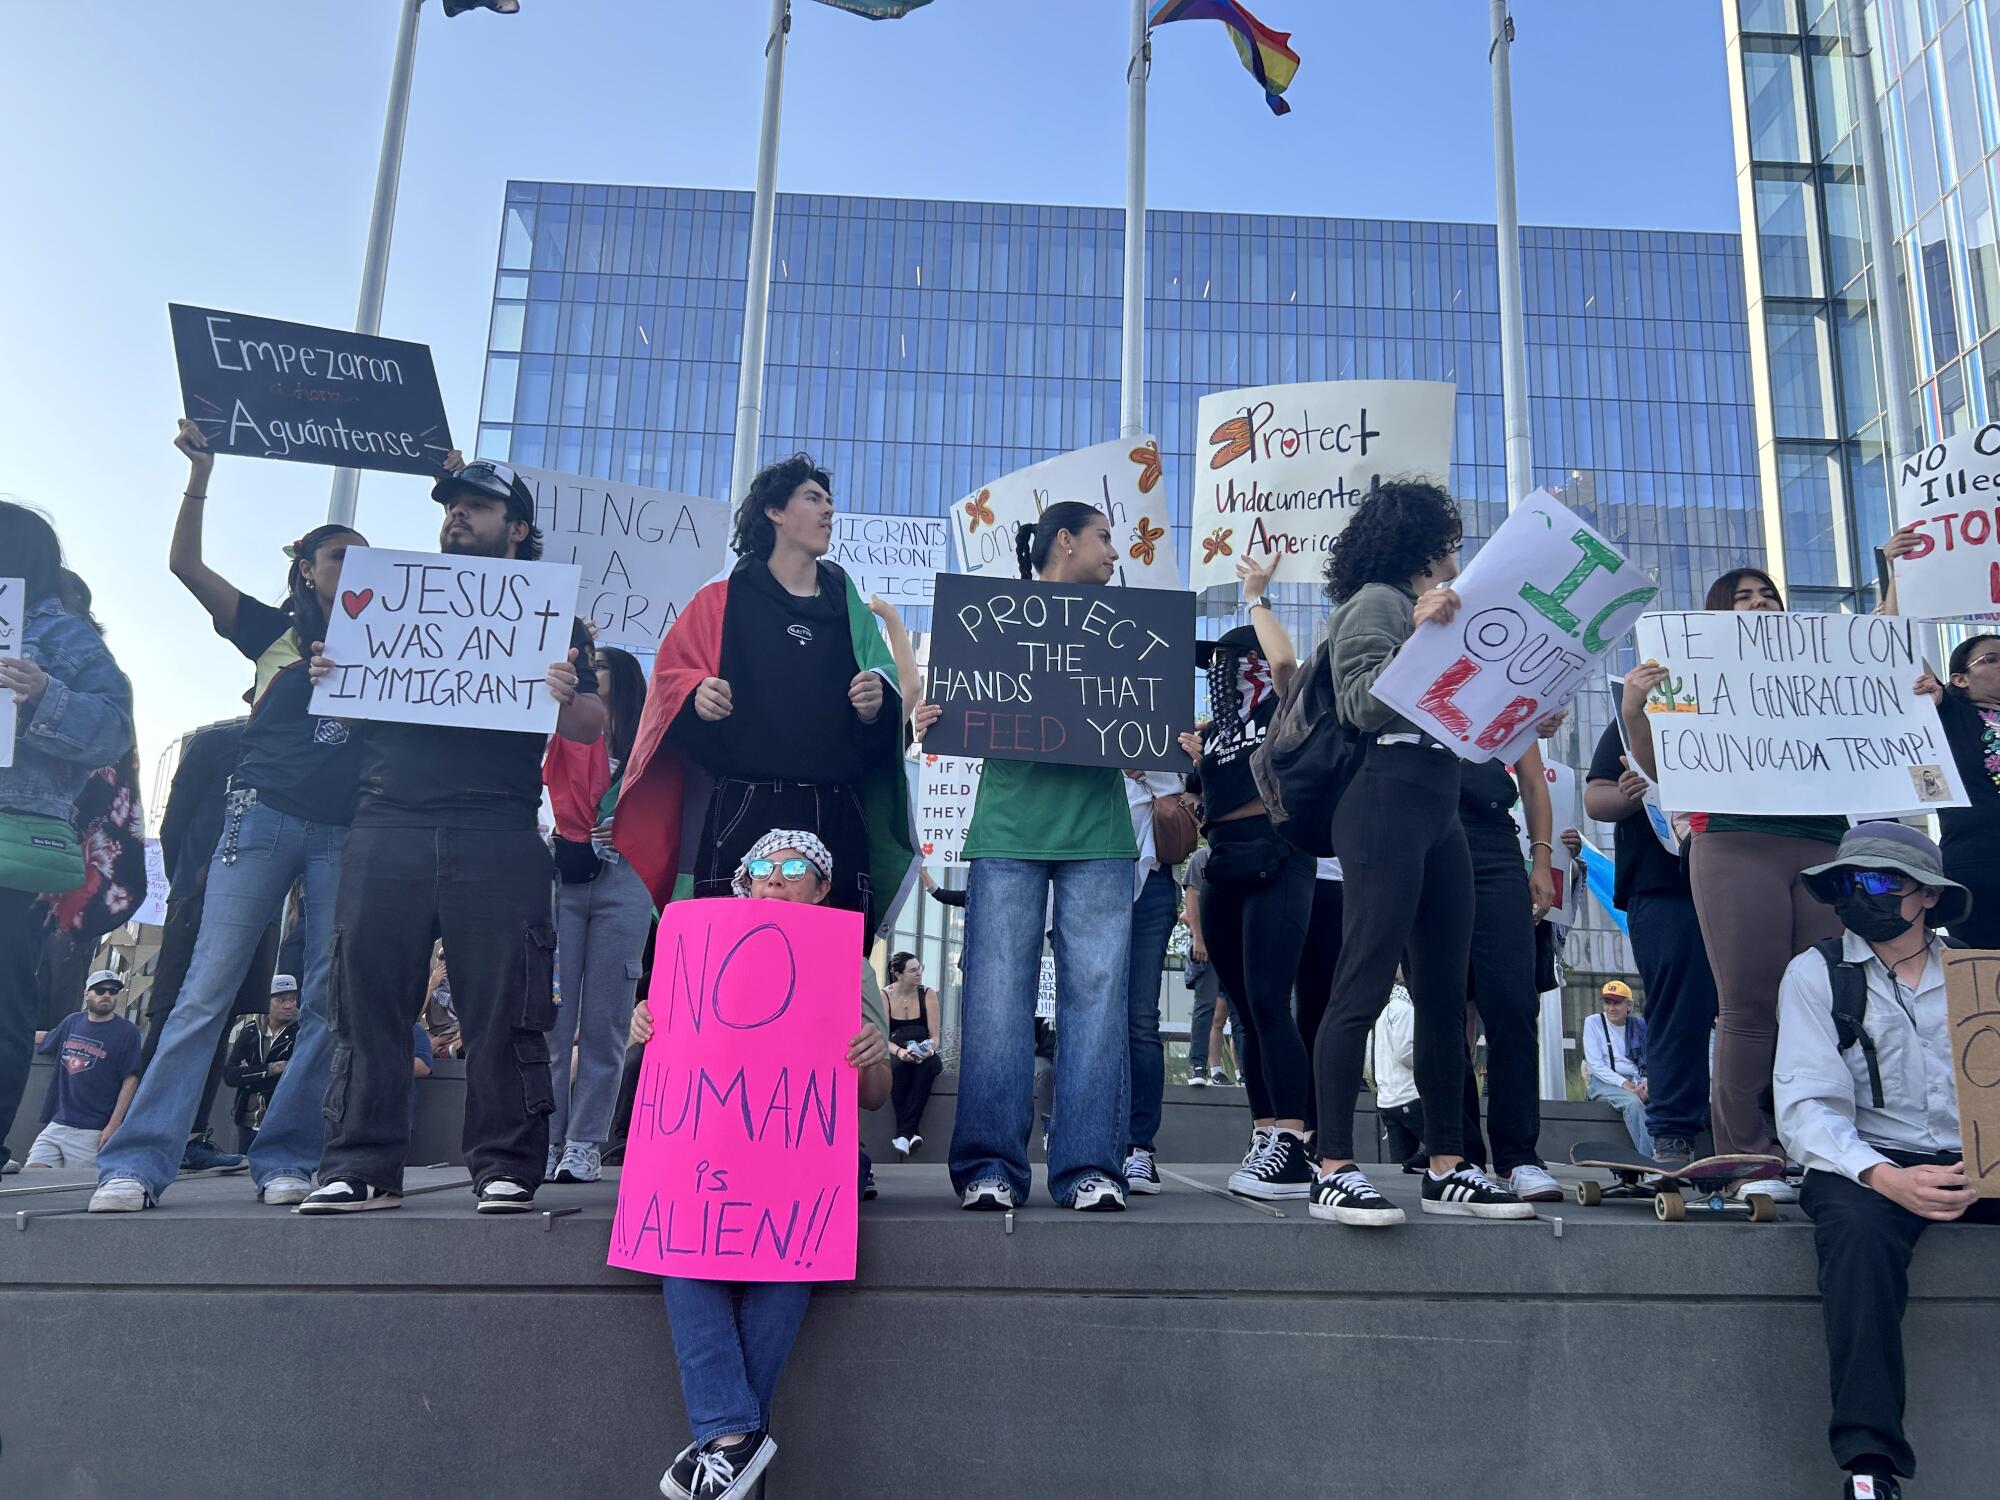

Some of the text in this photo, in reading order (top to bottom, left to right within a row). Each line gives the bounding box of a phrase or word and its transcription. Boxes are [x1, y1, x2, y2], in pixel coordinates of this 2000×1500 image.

[205, 315, 404, 386] Empezaron
[229, 398, 421, 458] Aguántense
[1247, 401, 1380, 464] Protect
[1901, 443, 1947, 488] NO
[1919, 468, 2000, 507] Ille
[520, 474, 701, 549] HINGA
[1902, 507, 2000, 561] STO
[380, 562, 531, 623] JESUS
[875, 576, 936, 597] ICE
[365, 623, 517, 662] WAS AN
[957, 594, 1170, 662] PROTECT
[1463, 606, 1587, 698] OUT
[1642, 612, 1914, 669] TE METISTE CON
[1016, 641, 1086, 673] THE
[328, 663, 548, 711] IMMIGRANT
[931, 666, 1164, 712] HANDS THAT
[1693, 671, 1905, 718] LA GENERACION
[962, 710, 1068, 753] FEED
[1086, 717, 1170, 759] YOU
[1661, 725, 1938, 773] EQUIVOCADA TRUMP!
[928, 784, 971, 796] HELD
[939, 762, 983, 776] IF YO
[923, 806, 967, 819] THEY
[923, 828, 954, 840] TRY
[667, 921, 797, 1035] NO
[636, 1060, 837, 1150] HUMAN
[695, 1160, 729, 1193] is
